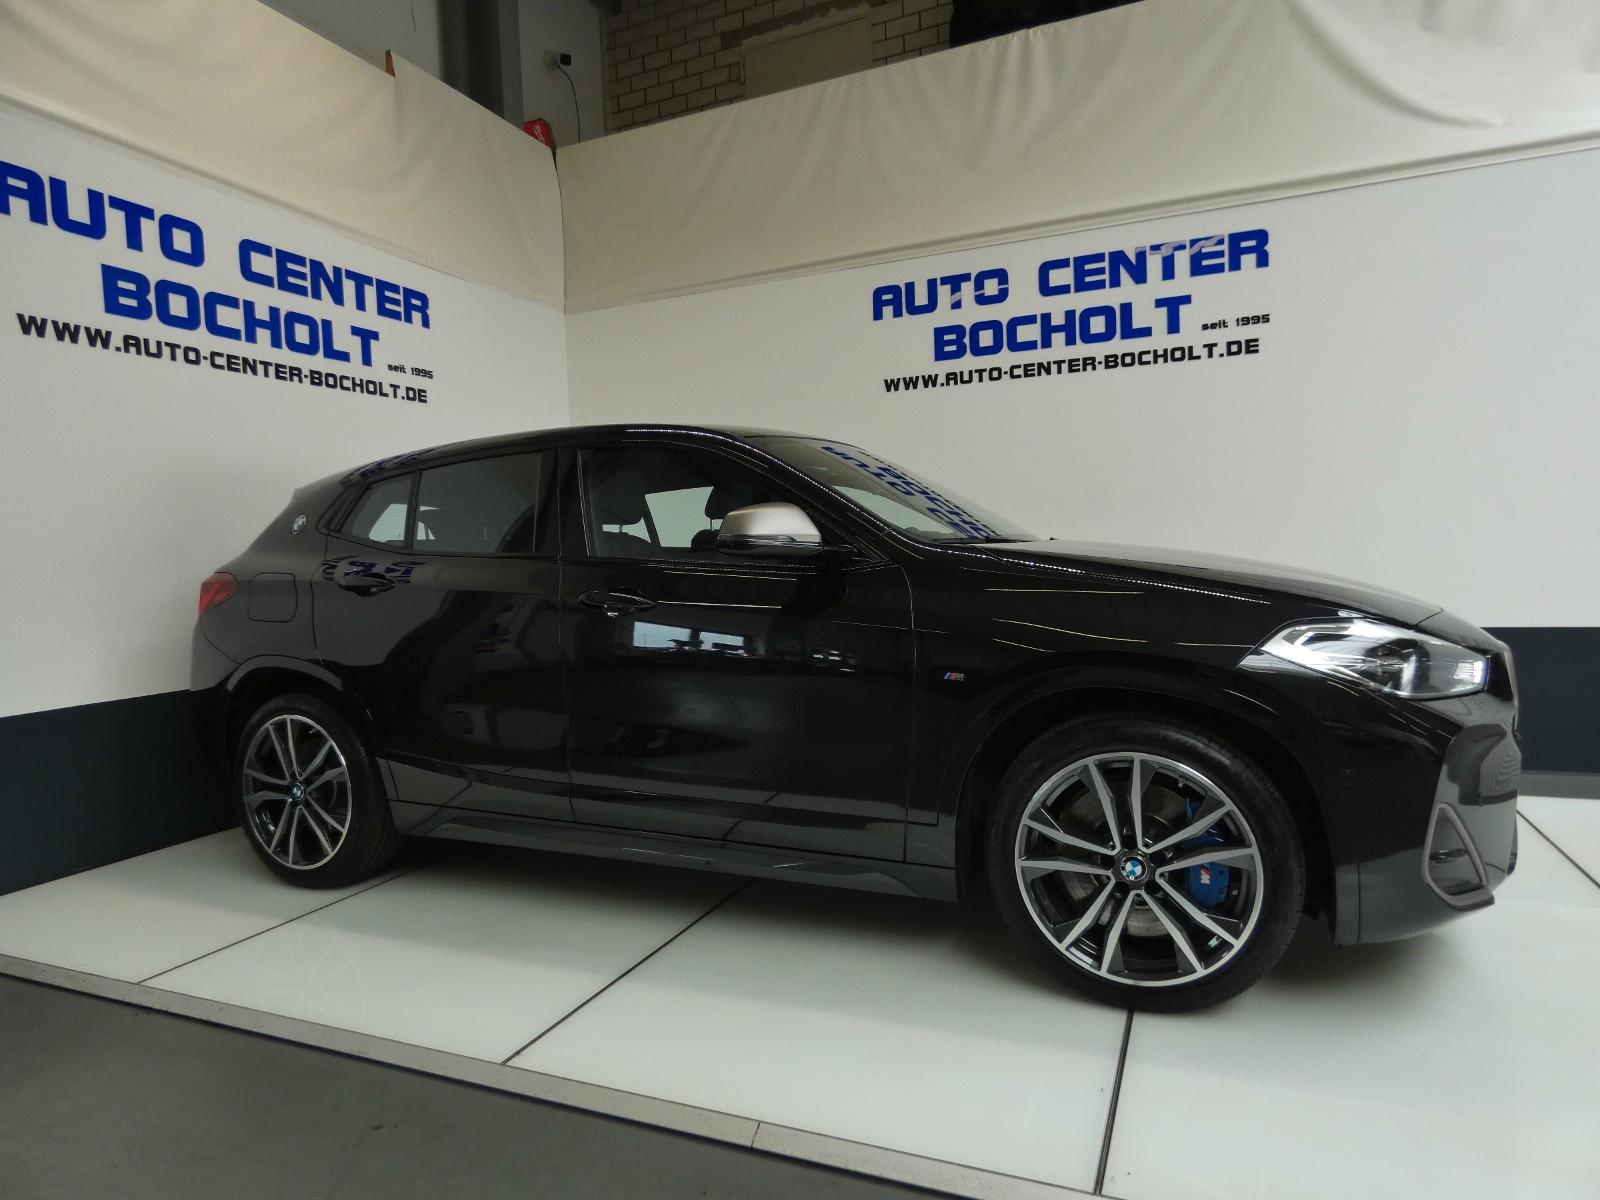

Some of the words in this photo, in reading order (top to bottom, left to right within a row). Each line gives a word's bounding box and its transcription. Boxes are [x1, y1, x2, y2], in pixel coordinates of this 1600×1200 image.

[0, 160, 206, 268] AUTO
[239, 239, 431, 329] CENTER
[872, 268, 1009, 321] AUTO
[1038, 229, 1270, 297] CENTER
[101, 264, 380, 368] BOCHOLT
[934, 294, 1192, 362] BOCHOLT
[1201, 319, 1229, 331] seit
[1235, 314, 1271, 327] 1995
[16, 312, 428, 404] WWW.AUTO-CENTER-BOCHOLT.DE
[387, 364, 407, 375] seit
[410, 367, 434, 379] 1995
[883, 338, 1260, 393] WWW.AUTO-CENTER-BOCHOLT.DE
